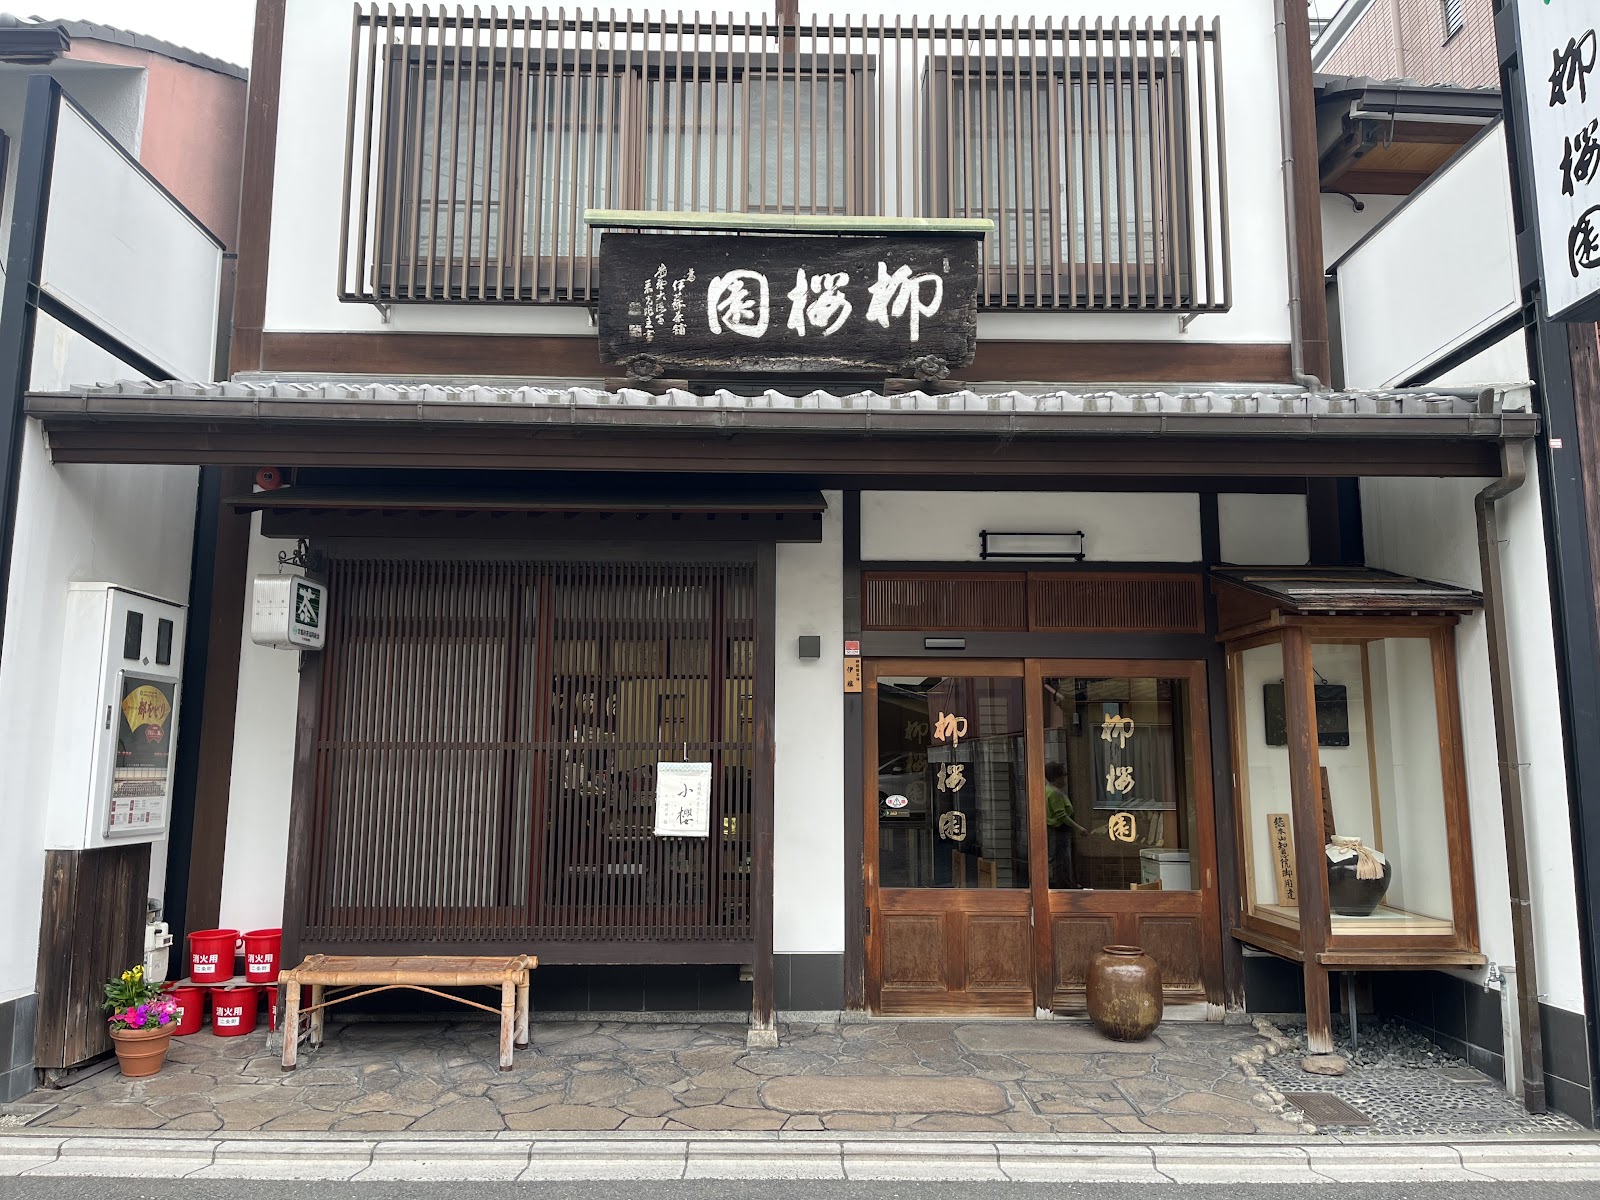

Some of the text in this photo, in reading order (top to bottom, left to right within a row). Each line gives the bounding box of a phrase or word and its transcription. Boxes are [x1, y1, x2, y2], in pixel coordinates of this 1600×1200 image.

[297, 588, 318, 624] 茶
[192, 953, 218, 964] 消火用
[247, 953, 274, 963] 消火用
[215, 1006, 243, 1016] 消火用
